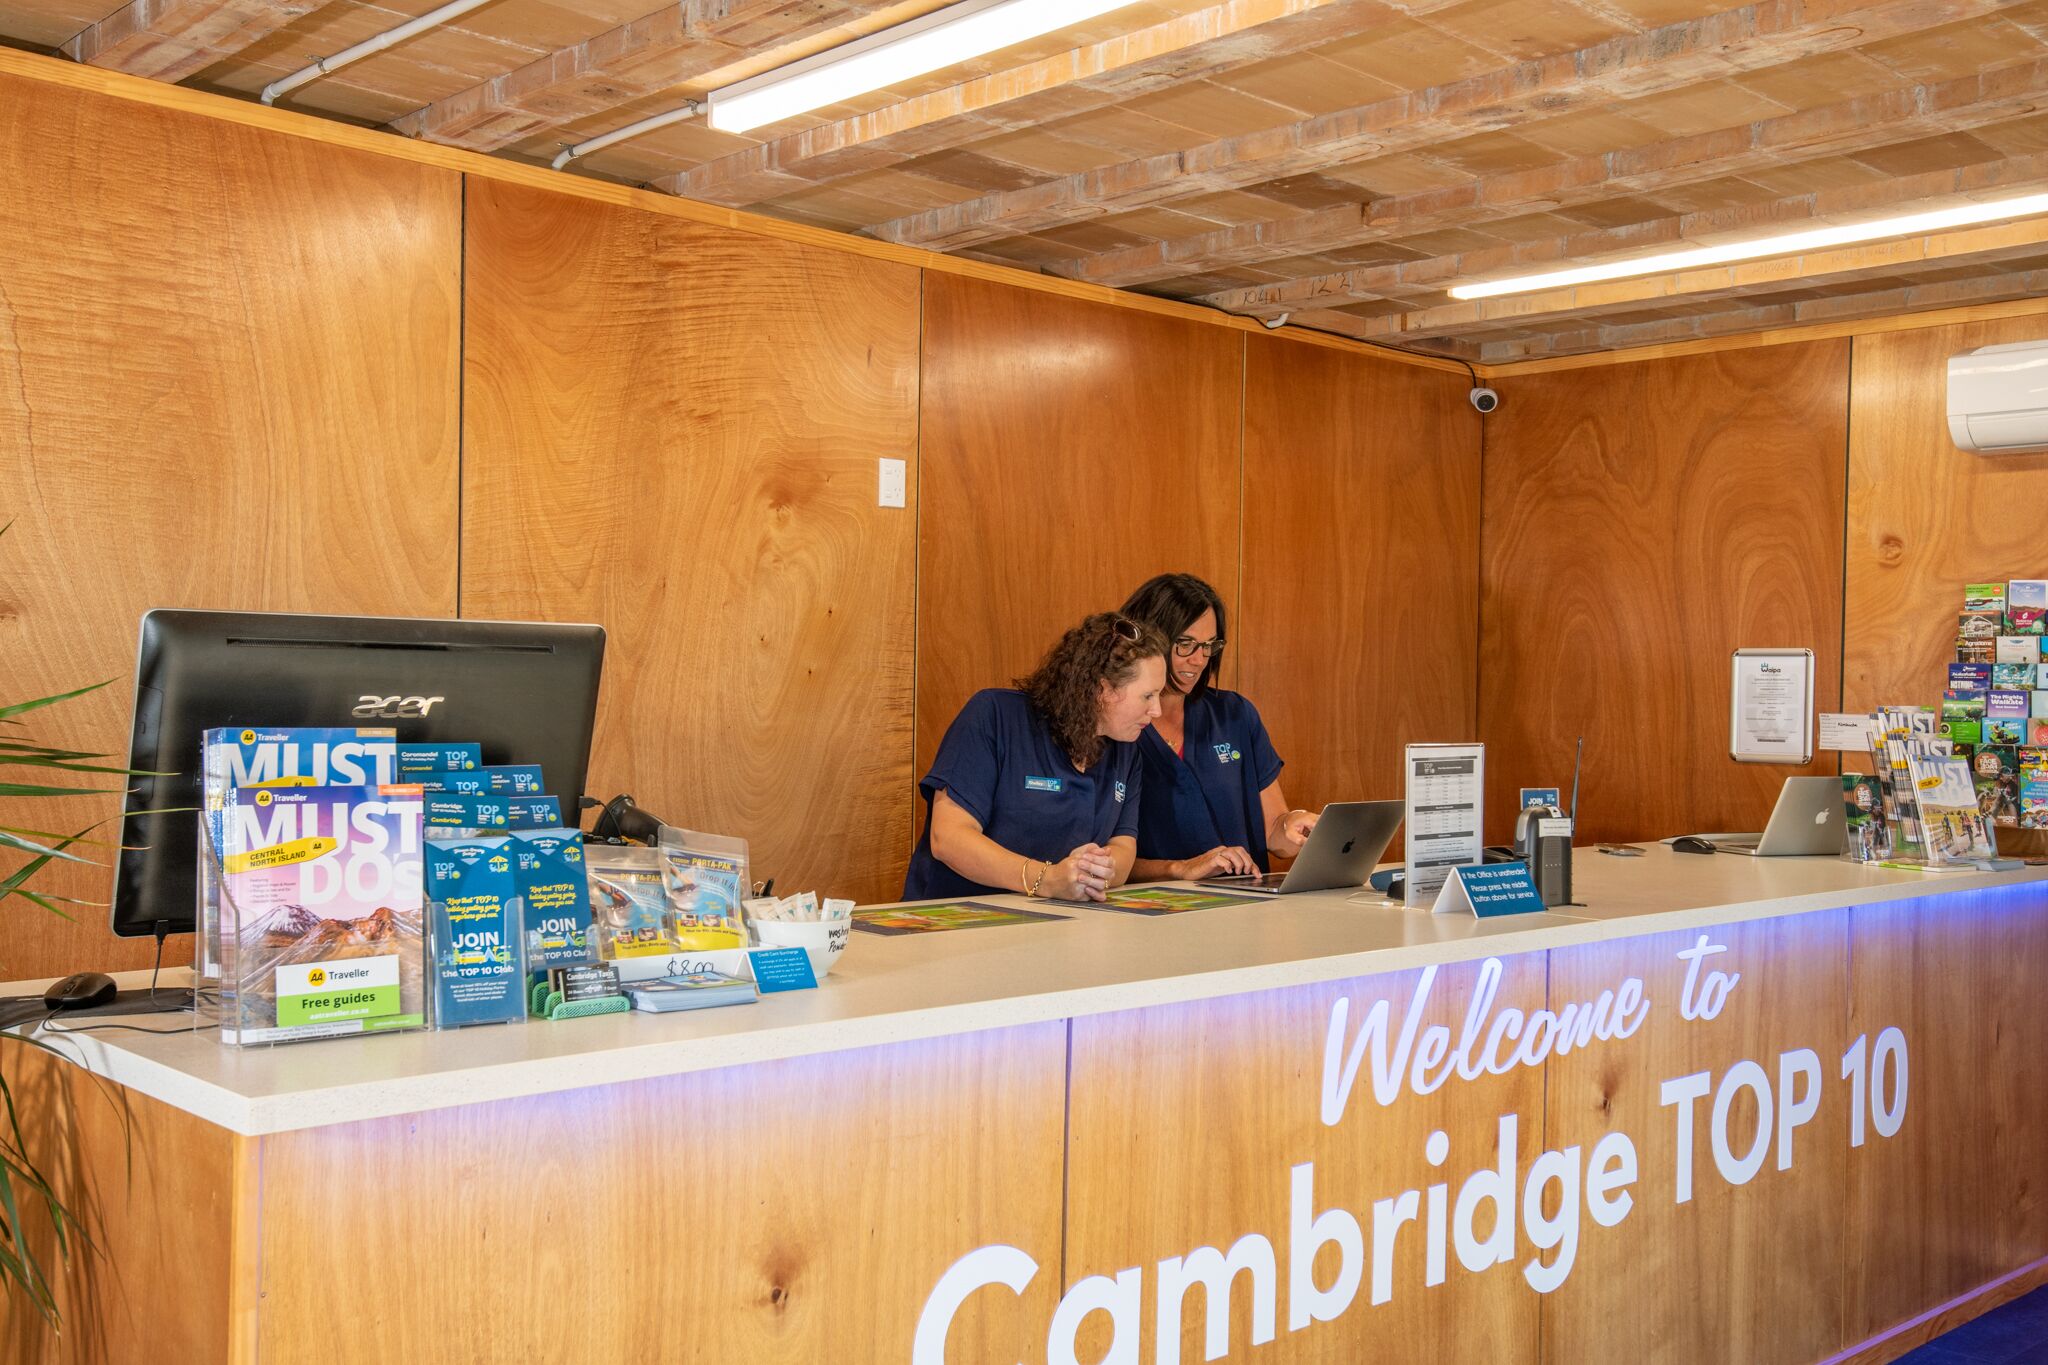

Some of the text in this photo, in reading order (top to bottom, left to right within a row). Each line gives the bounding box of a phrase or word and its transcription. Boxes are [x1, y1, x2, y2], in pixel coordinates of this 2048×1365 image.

[351, 695, 445, 719] acer
[1878, 712, 1935, 733] MUST
[257, 733, 288, 741] Traveller
[1213, 742, 1231, 755] TOP
[1897, 740, 1954, 756] MUST
[445, 751, 468, 761] TOP
[220, 743, 397, 787] MUST
[513, 773, 533, 783] TOP
[1913, 761, 1968, 786] MUST
[456, 781, 479, 791] TOP
[273, 794, 307, 802] Traveller
[476, 805, 500, 815] TOP
[530, 804, 550, 814] TOP
[431, 817, 462, 825] Cambridge
[236, 801, 424, 857] MUST
[250, 848, 284, 860] CENTRAL
[250, 850, 306, 867] NORTH ISLAND
[518, 853, 535, 862] TOP
[434, 863, 455, 872] TOP
[692, 857, 731, 871] PORTA-PAK
[700, 871, 719, 884] Drop
[1467, 871, 1477, 879] the
[1477, 870, 1493, 879] Office
[1498, 868, 1527, 878] unattended
[553, 884, 569, 892] TOP
[1470, 881, 1529, 892] Please press the middle
[473, 895, 492, 904] TOP
[1473, 891, 1535, 903] button above for service
[537, 917, 577, 934] JOIN
[452, 931, 499, 949] JOIN
[544, 951, 561, 960] TOP
[562, 950, 571, 958] 10
[329, 968, 370, 981] Traveller
[442, 964, 514, 978] the TOP 10 Club
[567, 972, 598, 981] Cambridge
[302, 992, 376, 1009] Free guides
[1320, 934, 1741, 1127] Welcome to
[912, 1026, 1909, 1365] Cambridge TOP 10
